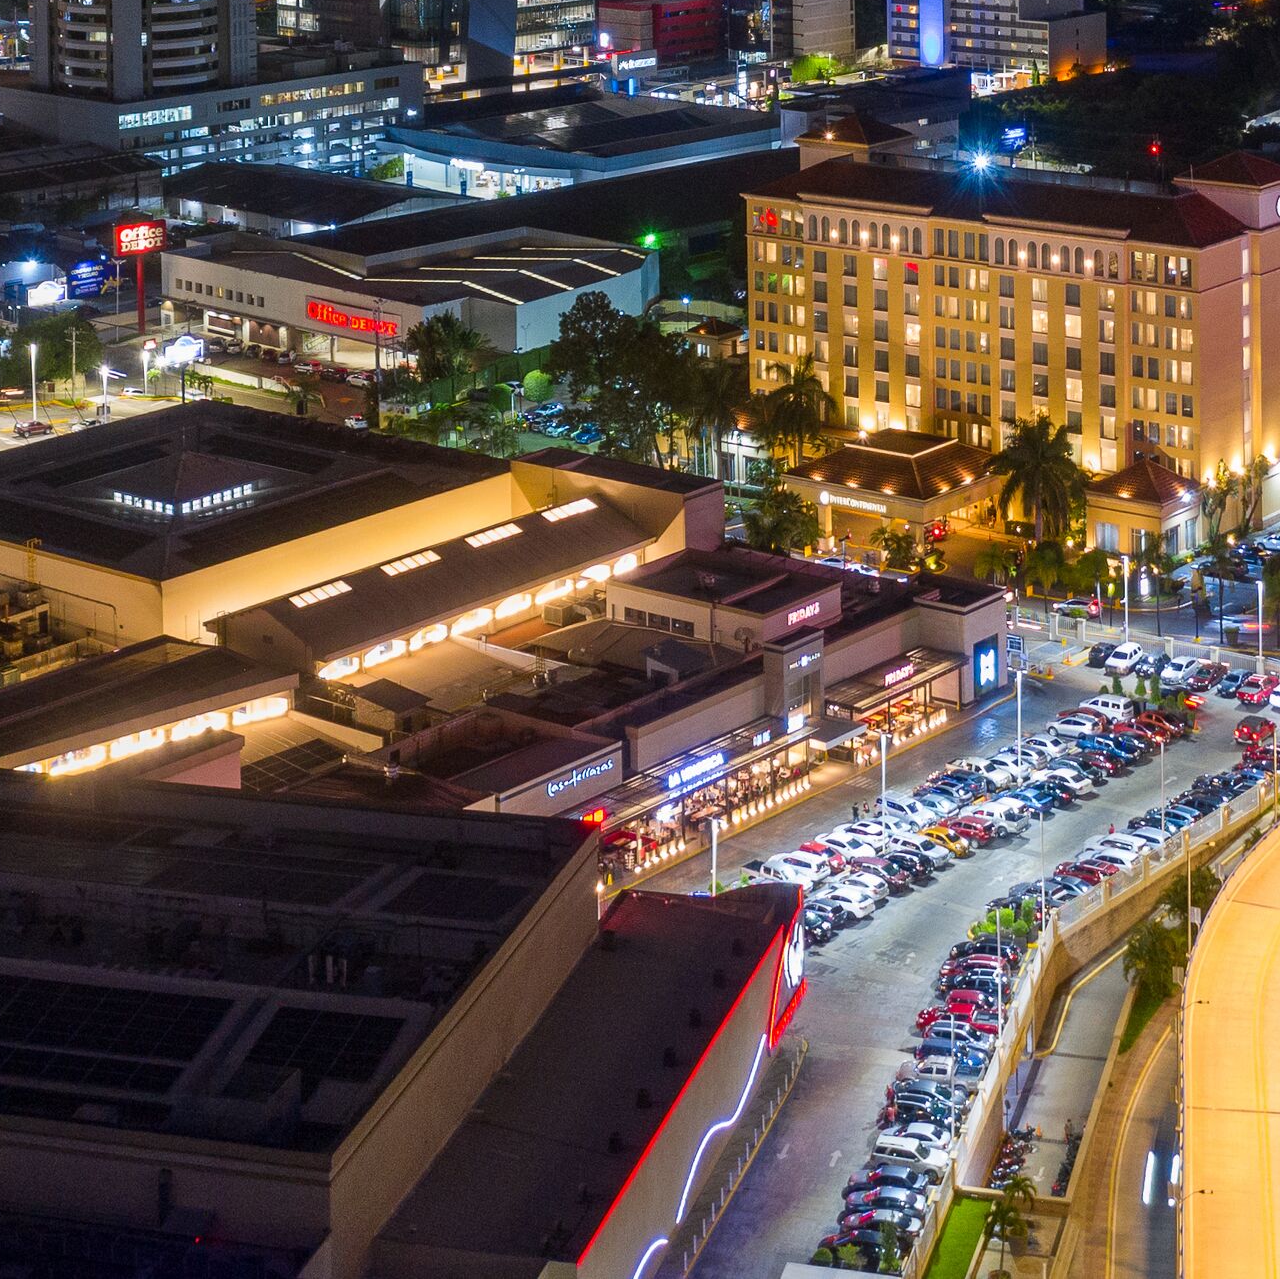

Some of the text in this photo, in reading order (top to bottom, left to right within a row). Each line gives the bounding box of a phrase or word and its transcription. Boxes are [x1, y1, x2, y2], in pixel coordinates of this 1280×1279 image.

[120, 226, 163, 242] Office
[121, 237, 163, 252] DEPOT
[308, 301, 398, 336] Office DEPOT
[787, 602, 819, 626] FRIDAYS
